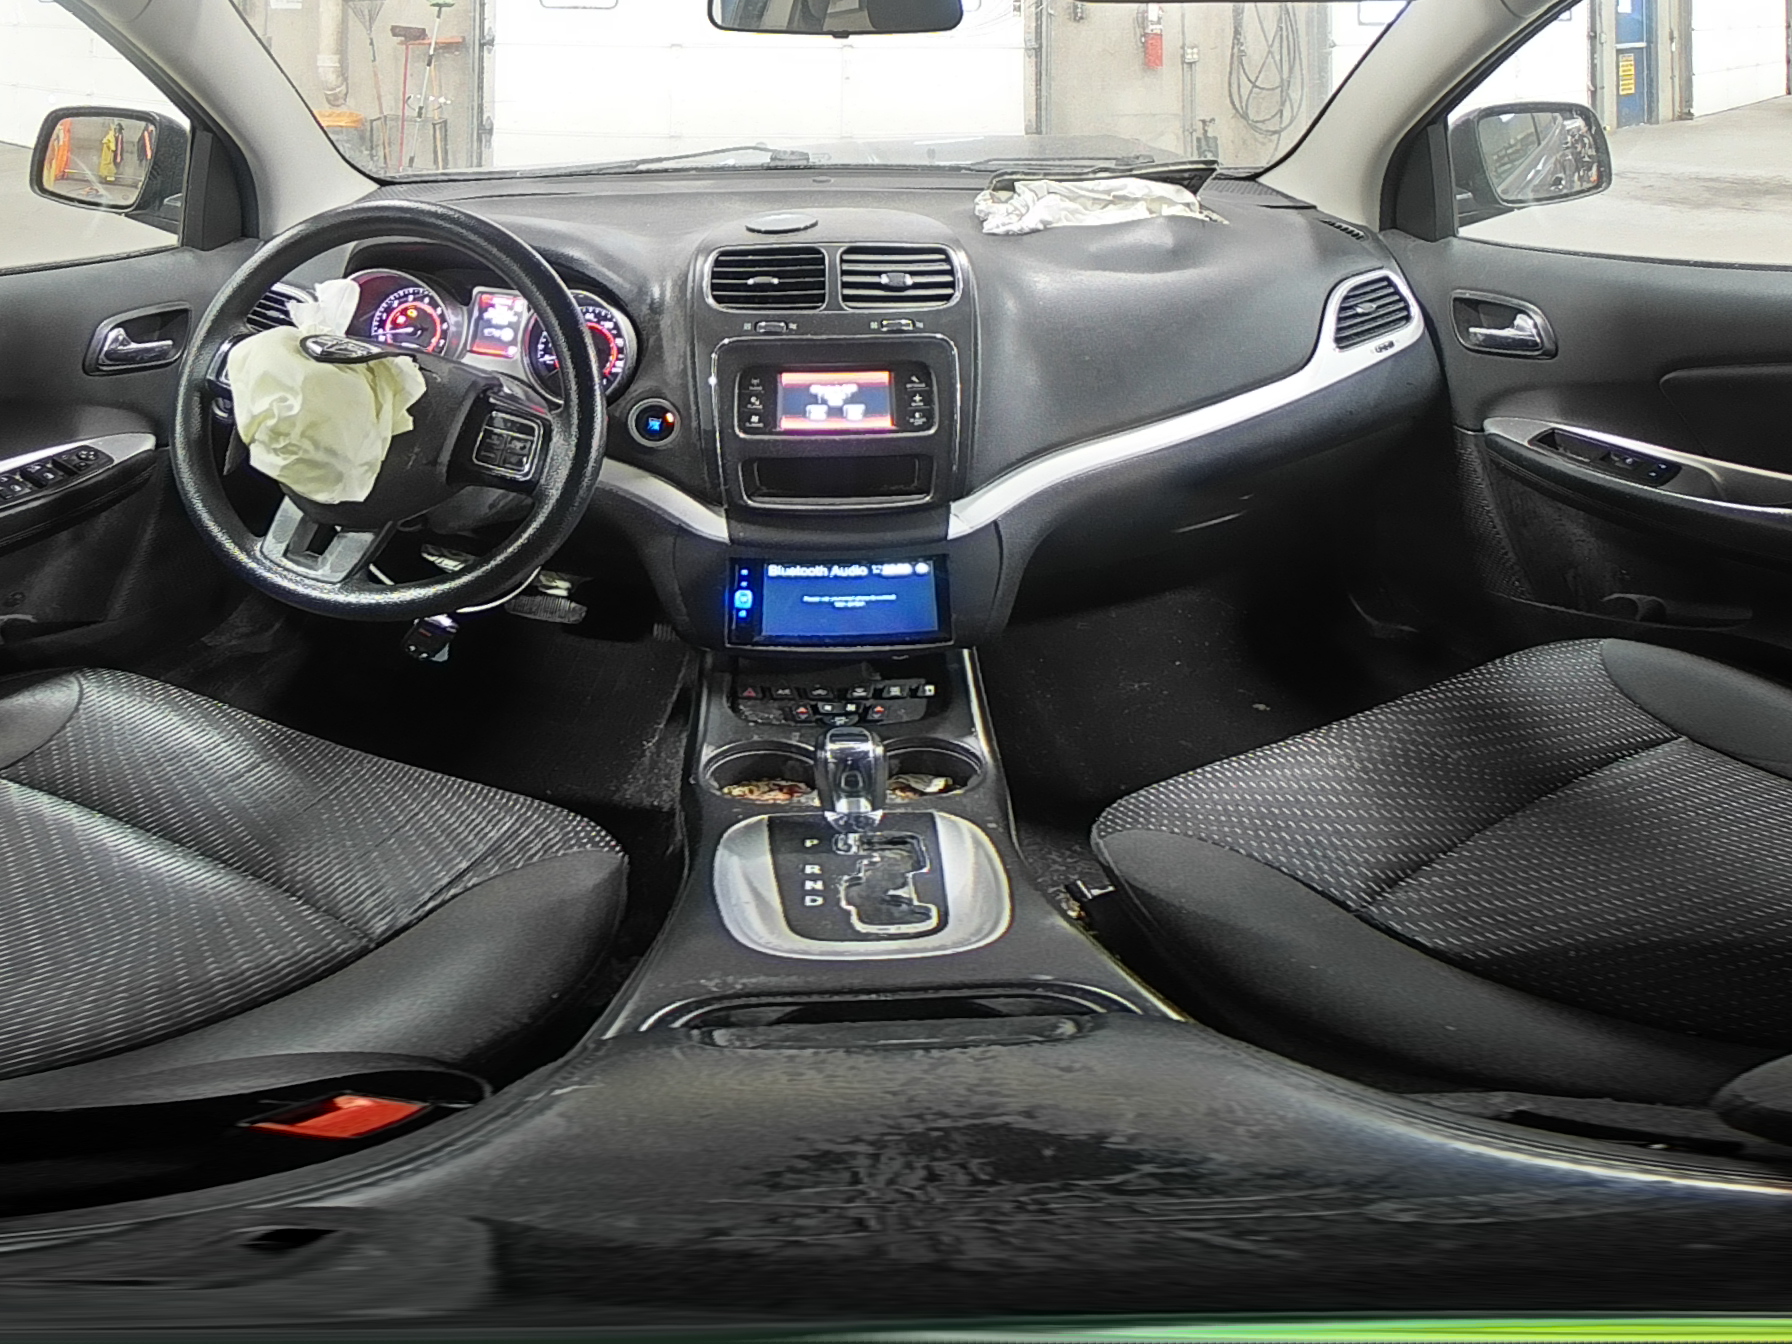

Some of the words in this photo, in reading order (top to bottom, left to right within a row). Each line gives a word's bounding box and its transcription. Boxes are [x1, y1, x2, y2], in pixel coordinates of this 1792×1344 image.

[768, 564, 828, 576] Bluetooth
[830, 564, 868, 577] Audio
[804, 839, 819, 847] P
[804, 865, 822, 874] R
[804, 880, 824, 890] N
[804, 896, 824, 906] D
